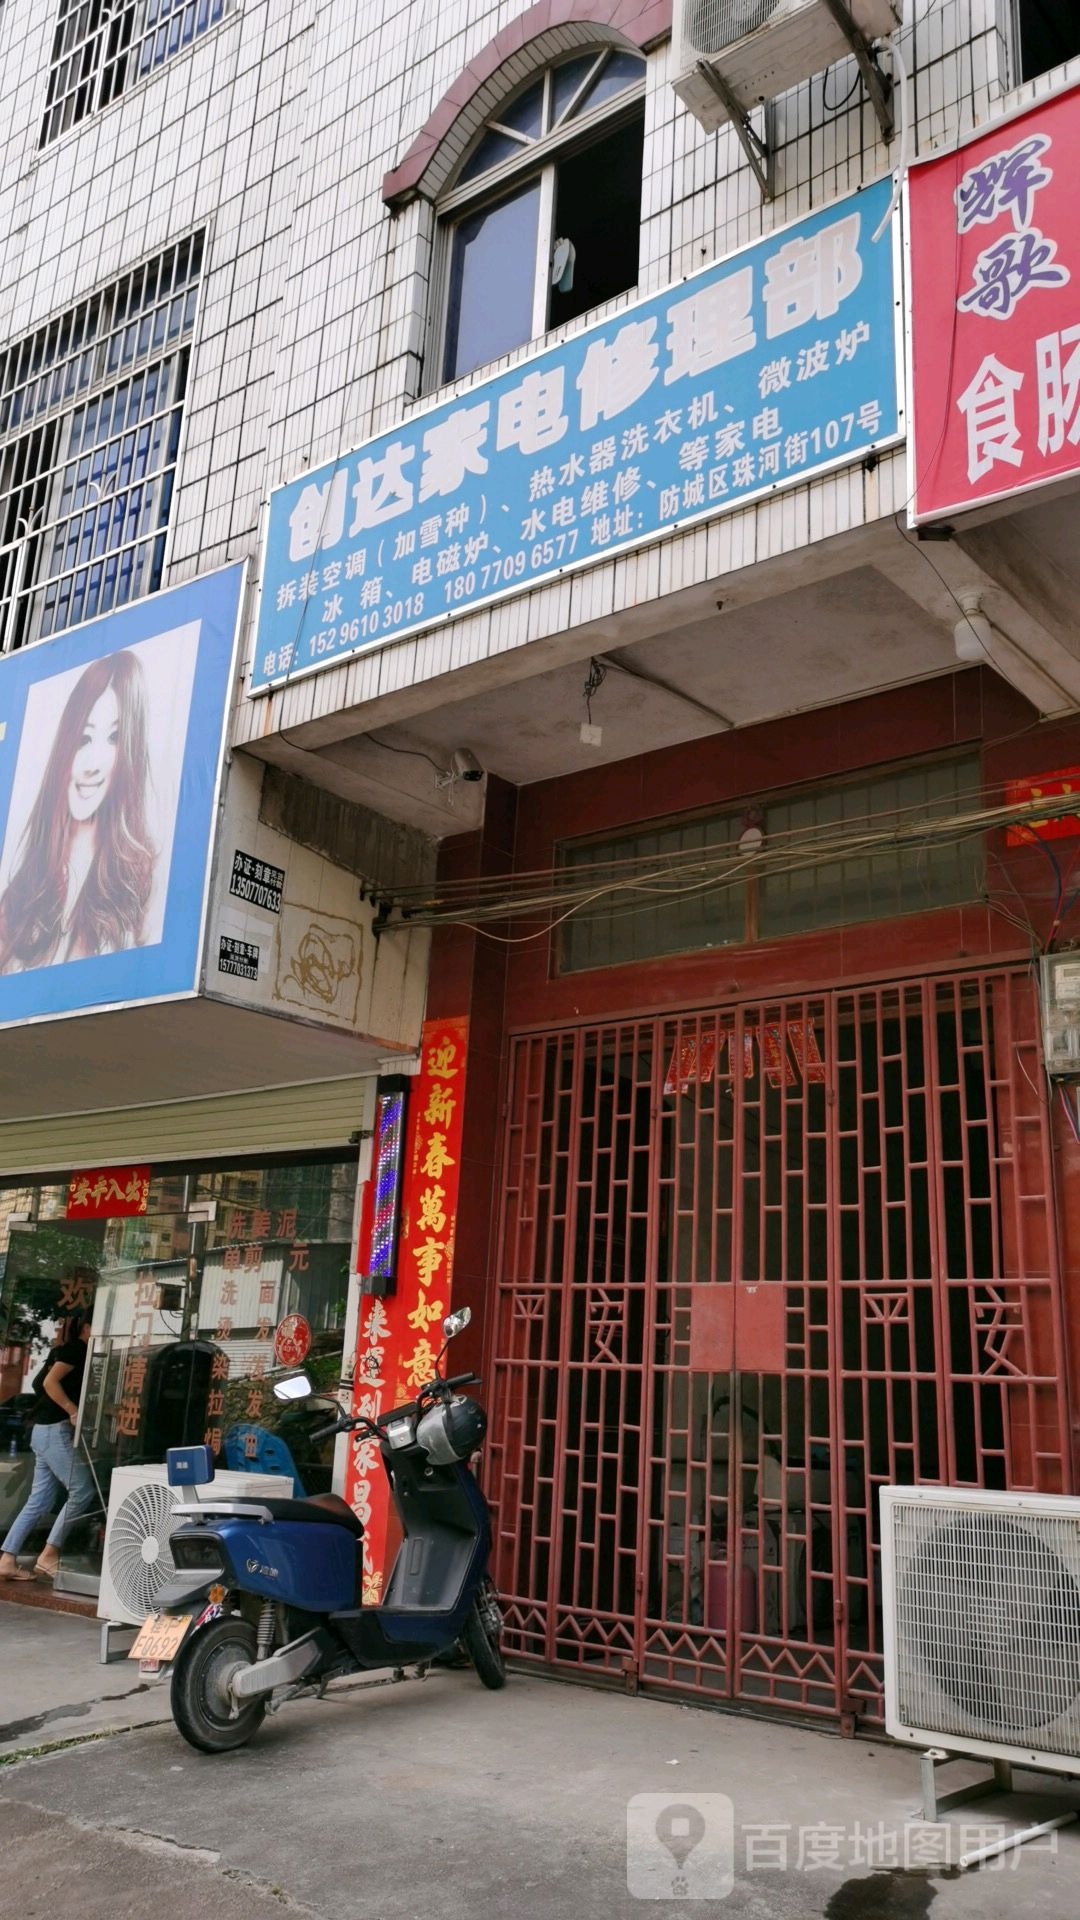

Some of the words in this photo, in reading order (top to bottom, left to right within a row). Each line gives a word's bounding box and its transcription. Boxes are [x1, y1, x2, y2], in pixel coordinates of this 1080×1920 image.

[288, 212, 863, 562] 创达家电修理部
[231, 873, 282, 912] 13507707633
[404, 1036, 459, 1389] 迎新春萬事如意
